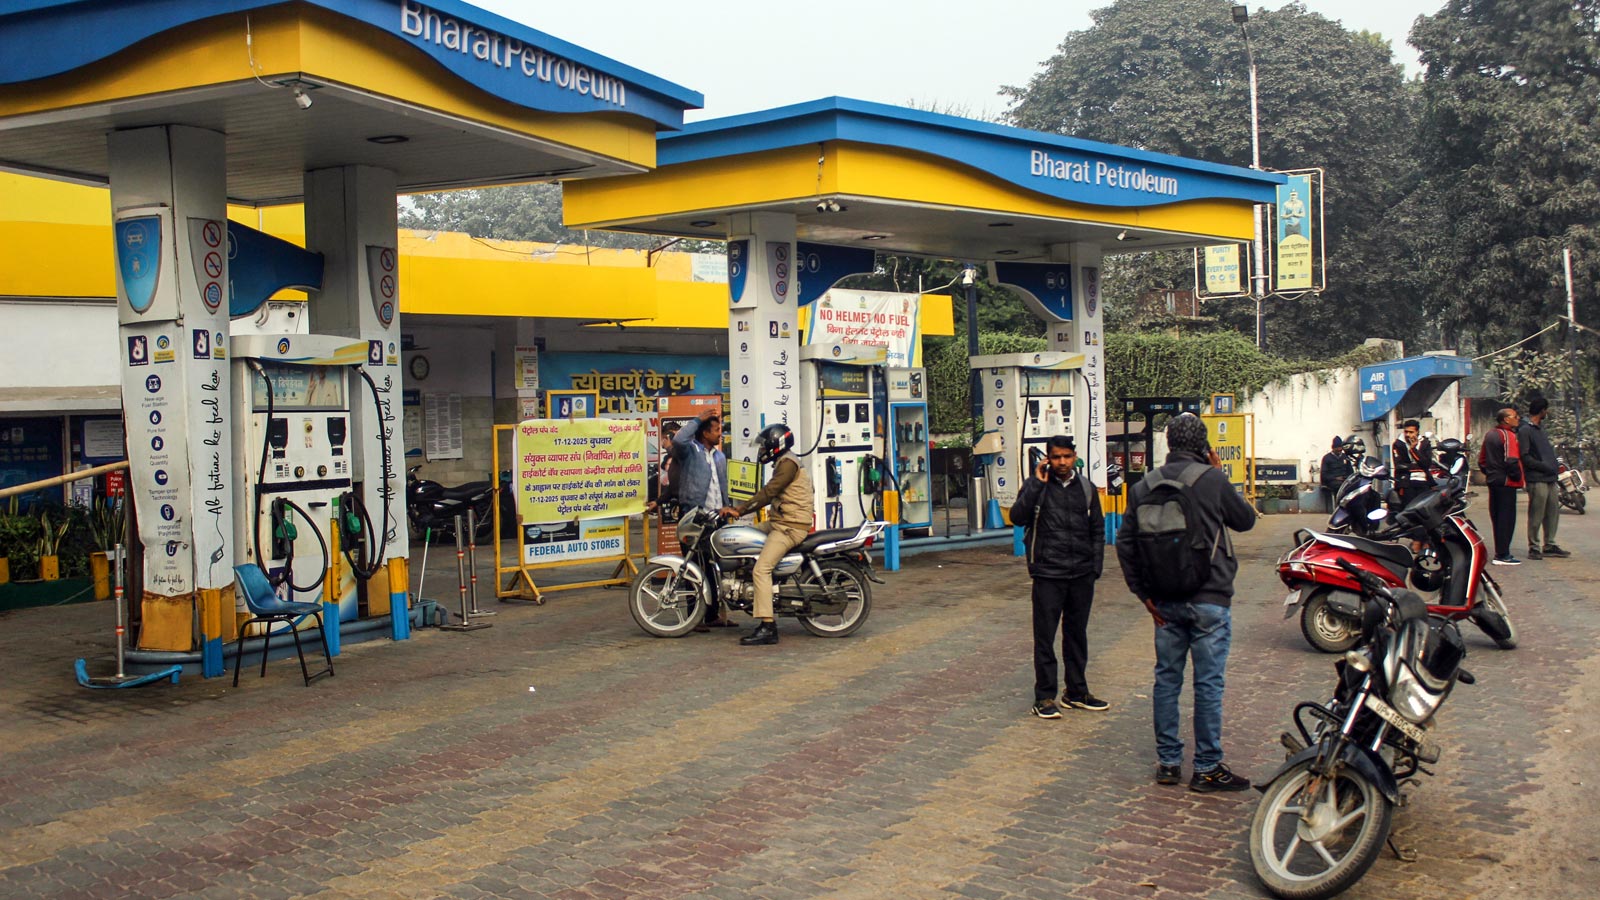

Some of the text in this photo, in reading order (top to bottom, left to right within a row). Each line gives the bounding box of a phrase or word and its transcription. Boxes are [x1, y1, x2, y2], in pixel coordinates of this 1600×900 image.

[401, 2, 626, 107] Bharat Petroleum
[1030, 150, 1178, 195] Bharat Petroleum
[820, 309, 910, 327] NO HELMET NO FUEL
[773, 349, 788, 366] kar
[201, 369, 221, 391] kar
[645, 370, 666, 390] के
[667, 370, 697, 390] रंग
[773, 370, 792, 390] feel
[1370, 372, 1385, 382] AIR
[599, 396, 631, 414] PCL
[774, 394, 790, 406] ko
[201, 396, 223, 424] feel
[203, 430, 221, 446] ko
[522, 425, 539, 436] पेट्रोल
[539, 425, 549, 433] पंप
[590, 437, 612, 448] बुधवार
[524, 453, 546, 466] संयुक्त
[547, 454, 568, 462] व्यापार
[570, 451, 581, 461] संघ
[618, 449, 631, 460] मेरठ
[207, 451, 224, 491] future
[522, 468, 546, 478] हाईकोर्ट
[624, 464, 642, 473] समिति
[205, 495, 224, 515] Ab
[529, 539, 620, 556] FEDERAL AUTO STORES
